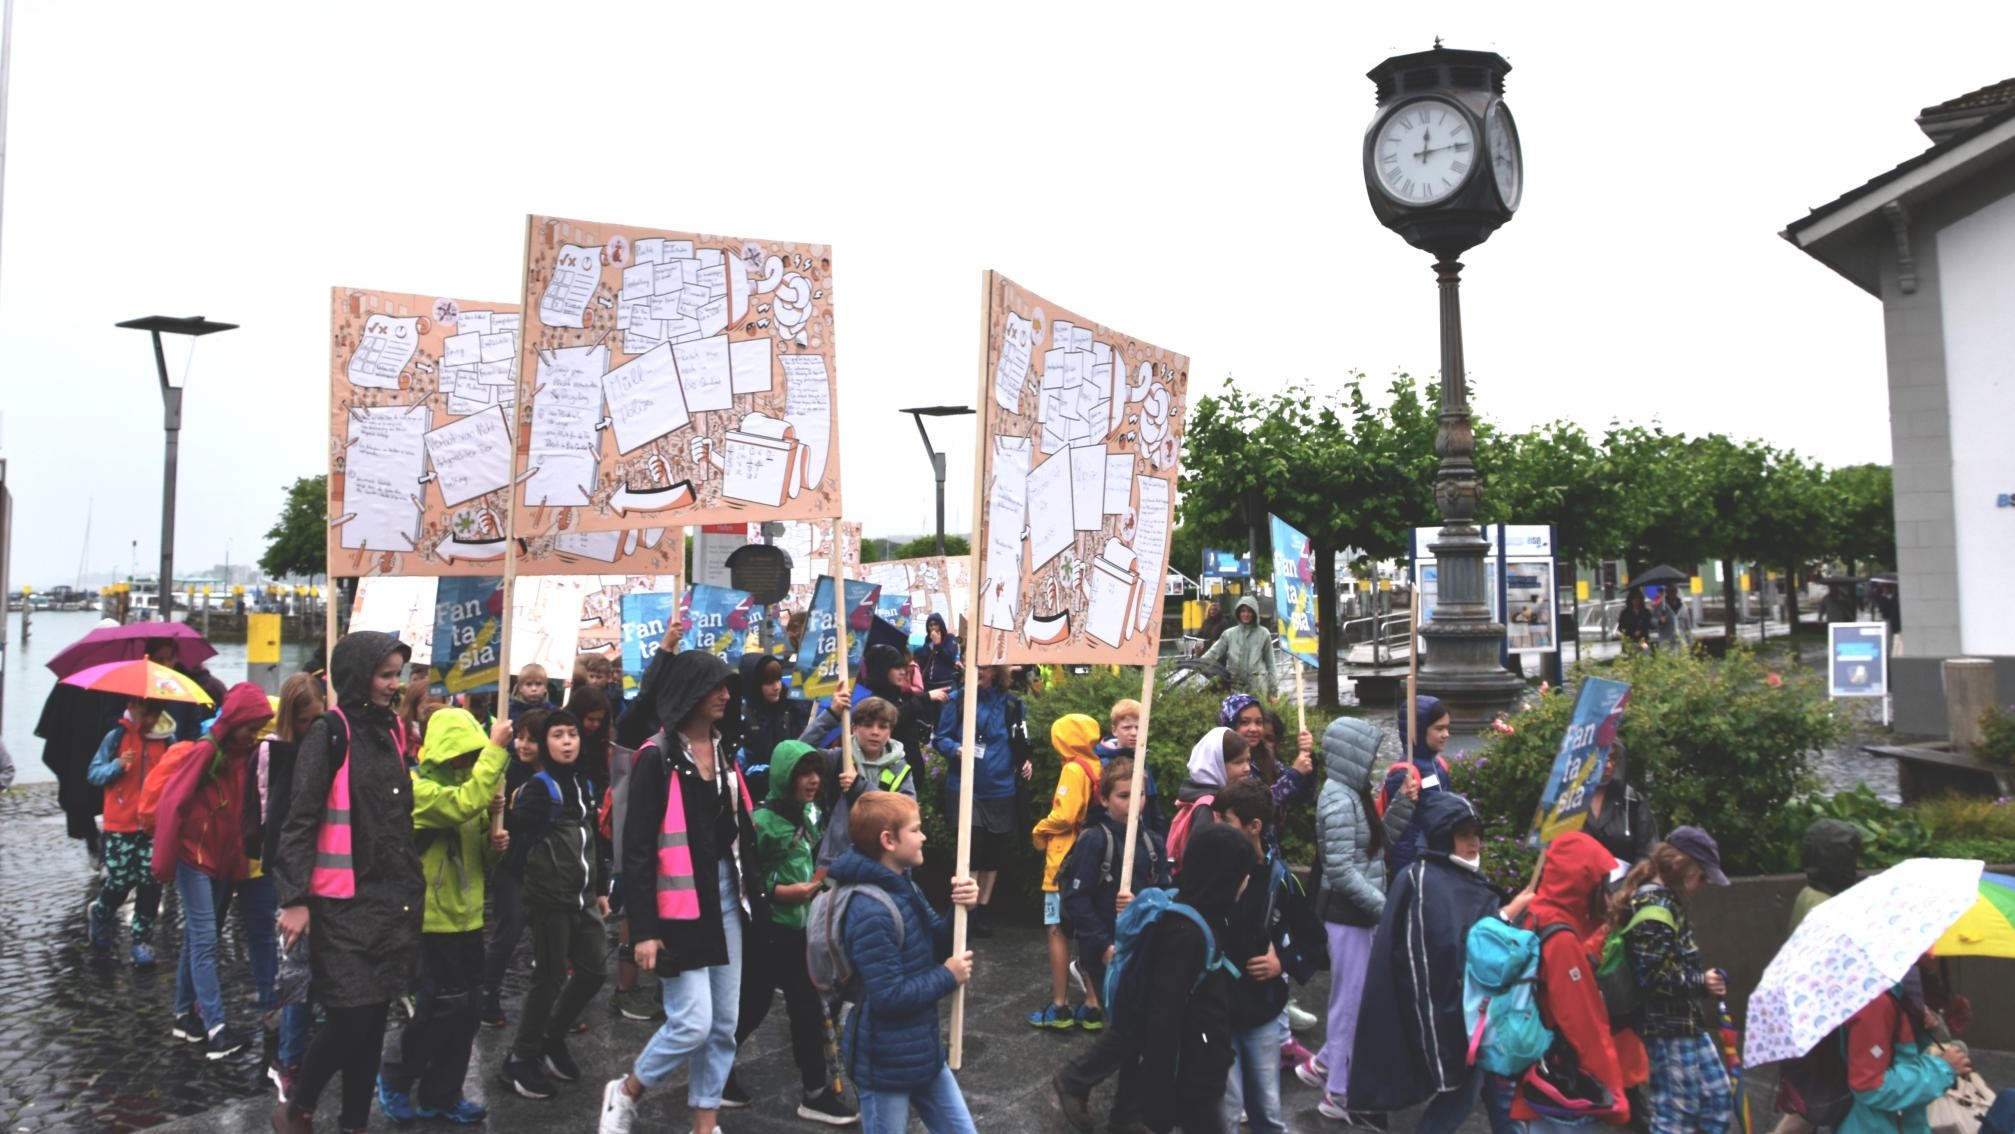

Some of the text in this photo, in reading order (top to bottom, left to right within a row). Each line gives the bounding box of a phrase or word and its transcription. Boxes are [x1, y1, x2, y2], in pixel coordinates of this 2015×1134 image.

[1285, 581, 1298, 605] ta
[436, 599, 482, 625] Fan
[452, 624, 475, 647] ta
[696, 630, 715, 648] ta
[459, 642, 495, 670] sia
[1561, 723, 1596, 754] Fan
[1563, 754, 1582, 783] ta
[1557, 782, 1585, 813] sia
